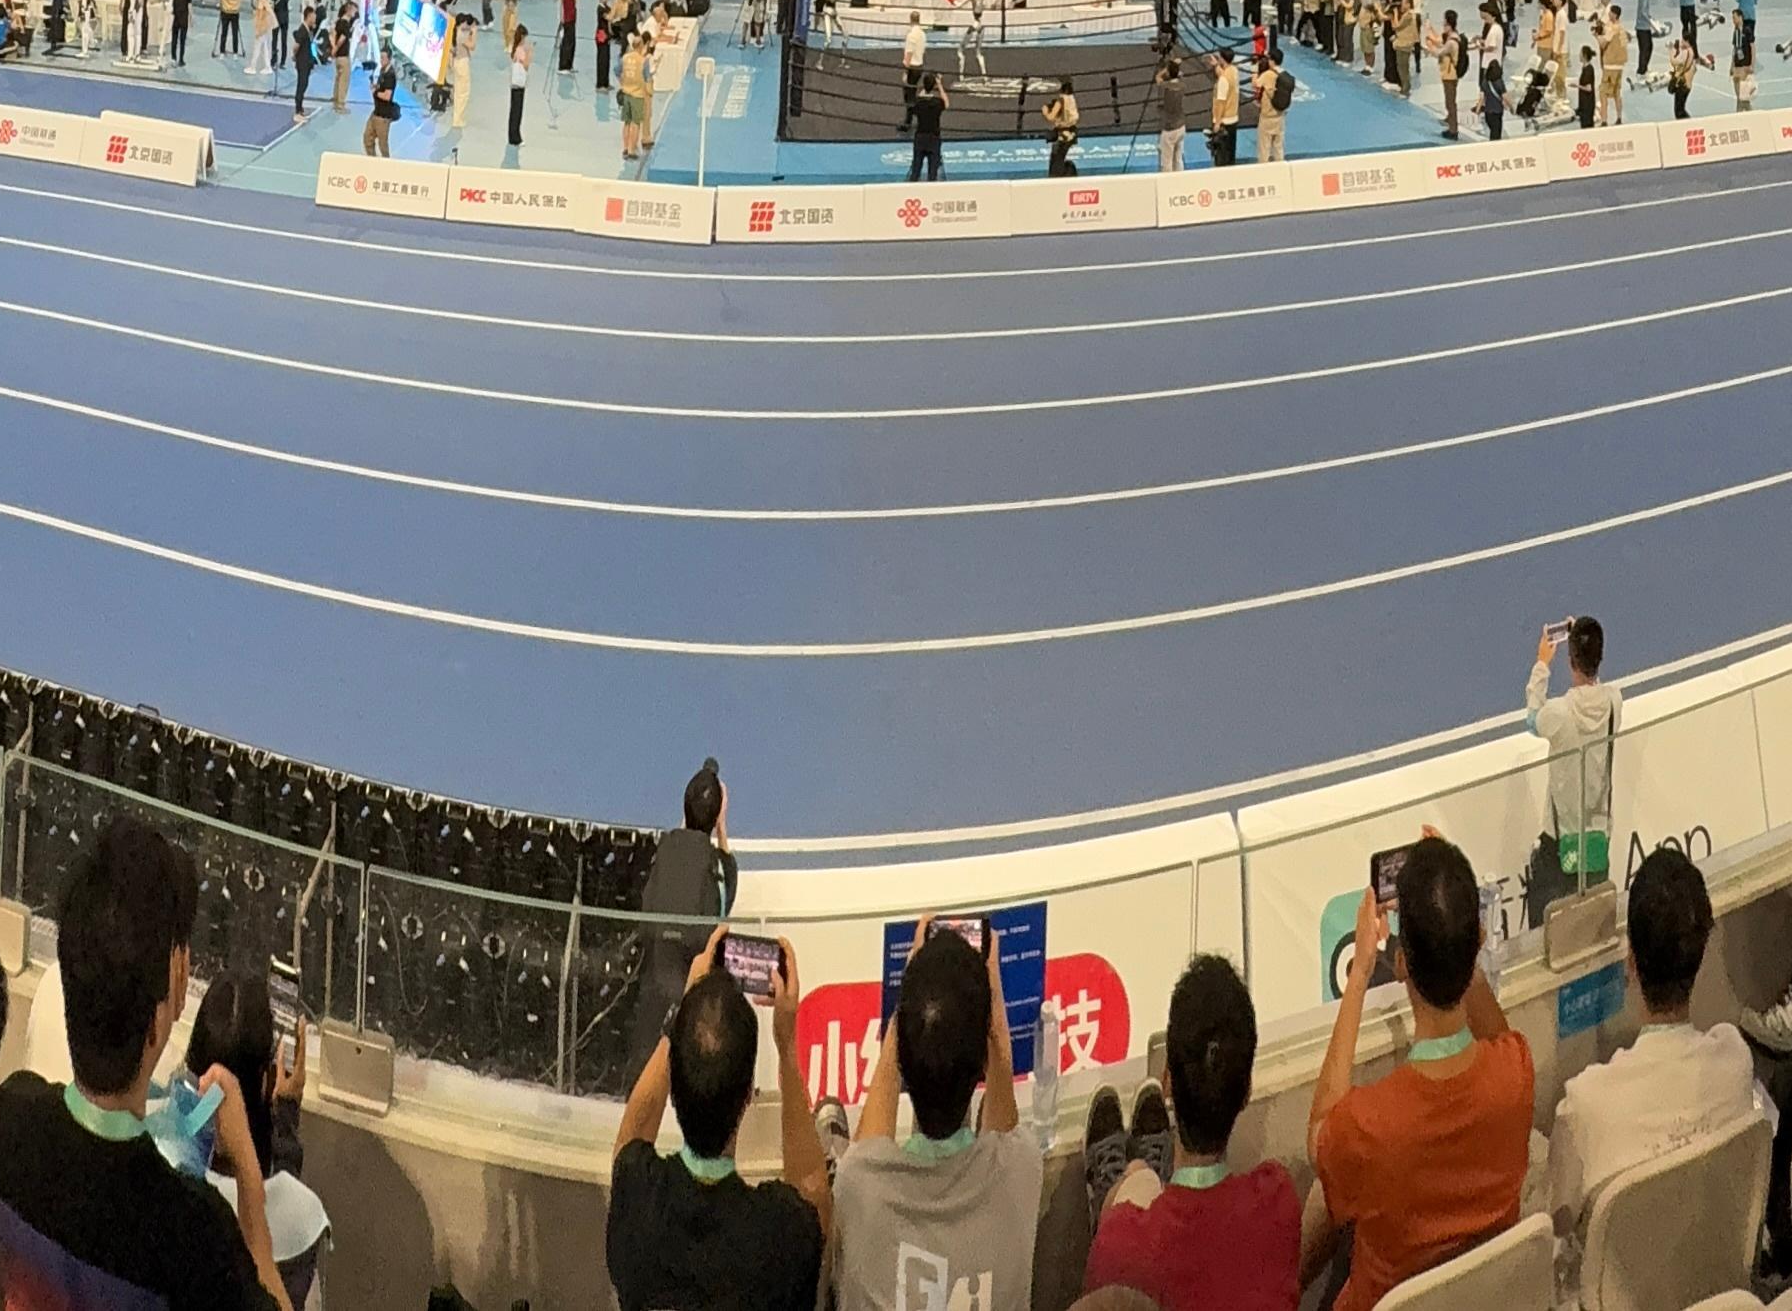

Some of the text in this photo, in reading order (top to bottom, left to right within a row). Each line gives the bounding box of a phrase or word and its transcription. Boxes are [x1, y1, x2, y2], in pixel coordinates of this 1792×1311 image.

[21, 125, 57, 140] 中国联通
[1708, 128, 1750, 147] 北京国资
[129, 144, 172, 166] 北京国资
[1436, 164, 1462, 180] PICC
[1464, 156, 1537, 176] 中国人民保险
[327, 175, 352, 189] ICBC
[1342, 167, 1396, 188] 首钢基金
[372, 180, 430, 199] 中国工商银行
[459, 187, 487, 204] PICC
[1217, 185, 1277, 202] 中国工商银行
[490, 190, 568, 209] 中国人民保险
[932, 200, 978, 214] 中国联通
[1168, 194, 1195, 208] ICBC
[626, 199, 682, 221] 首钢基金
[778, 207, 834, 225] 北京国资
